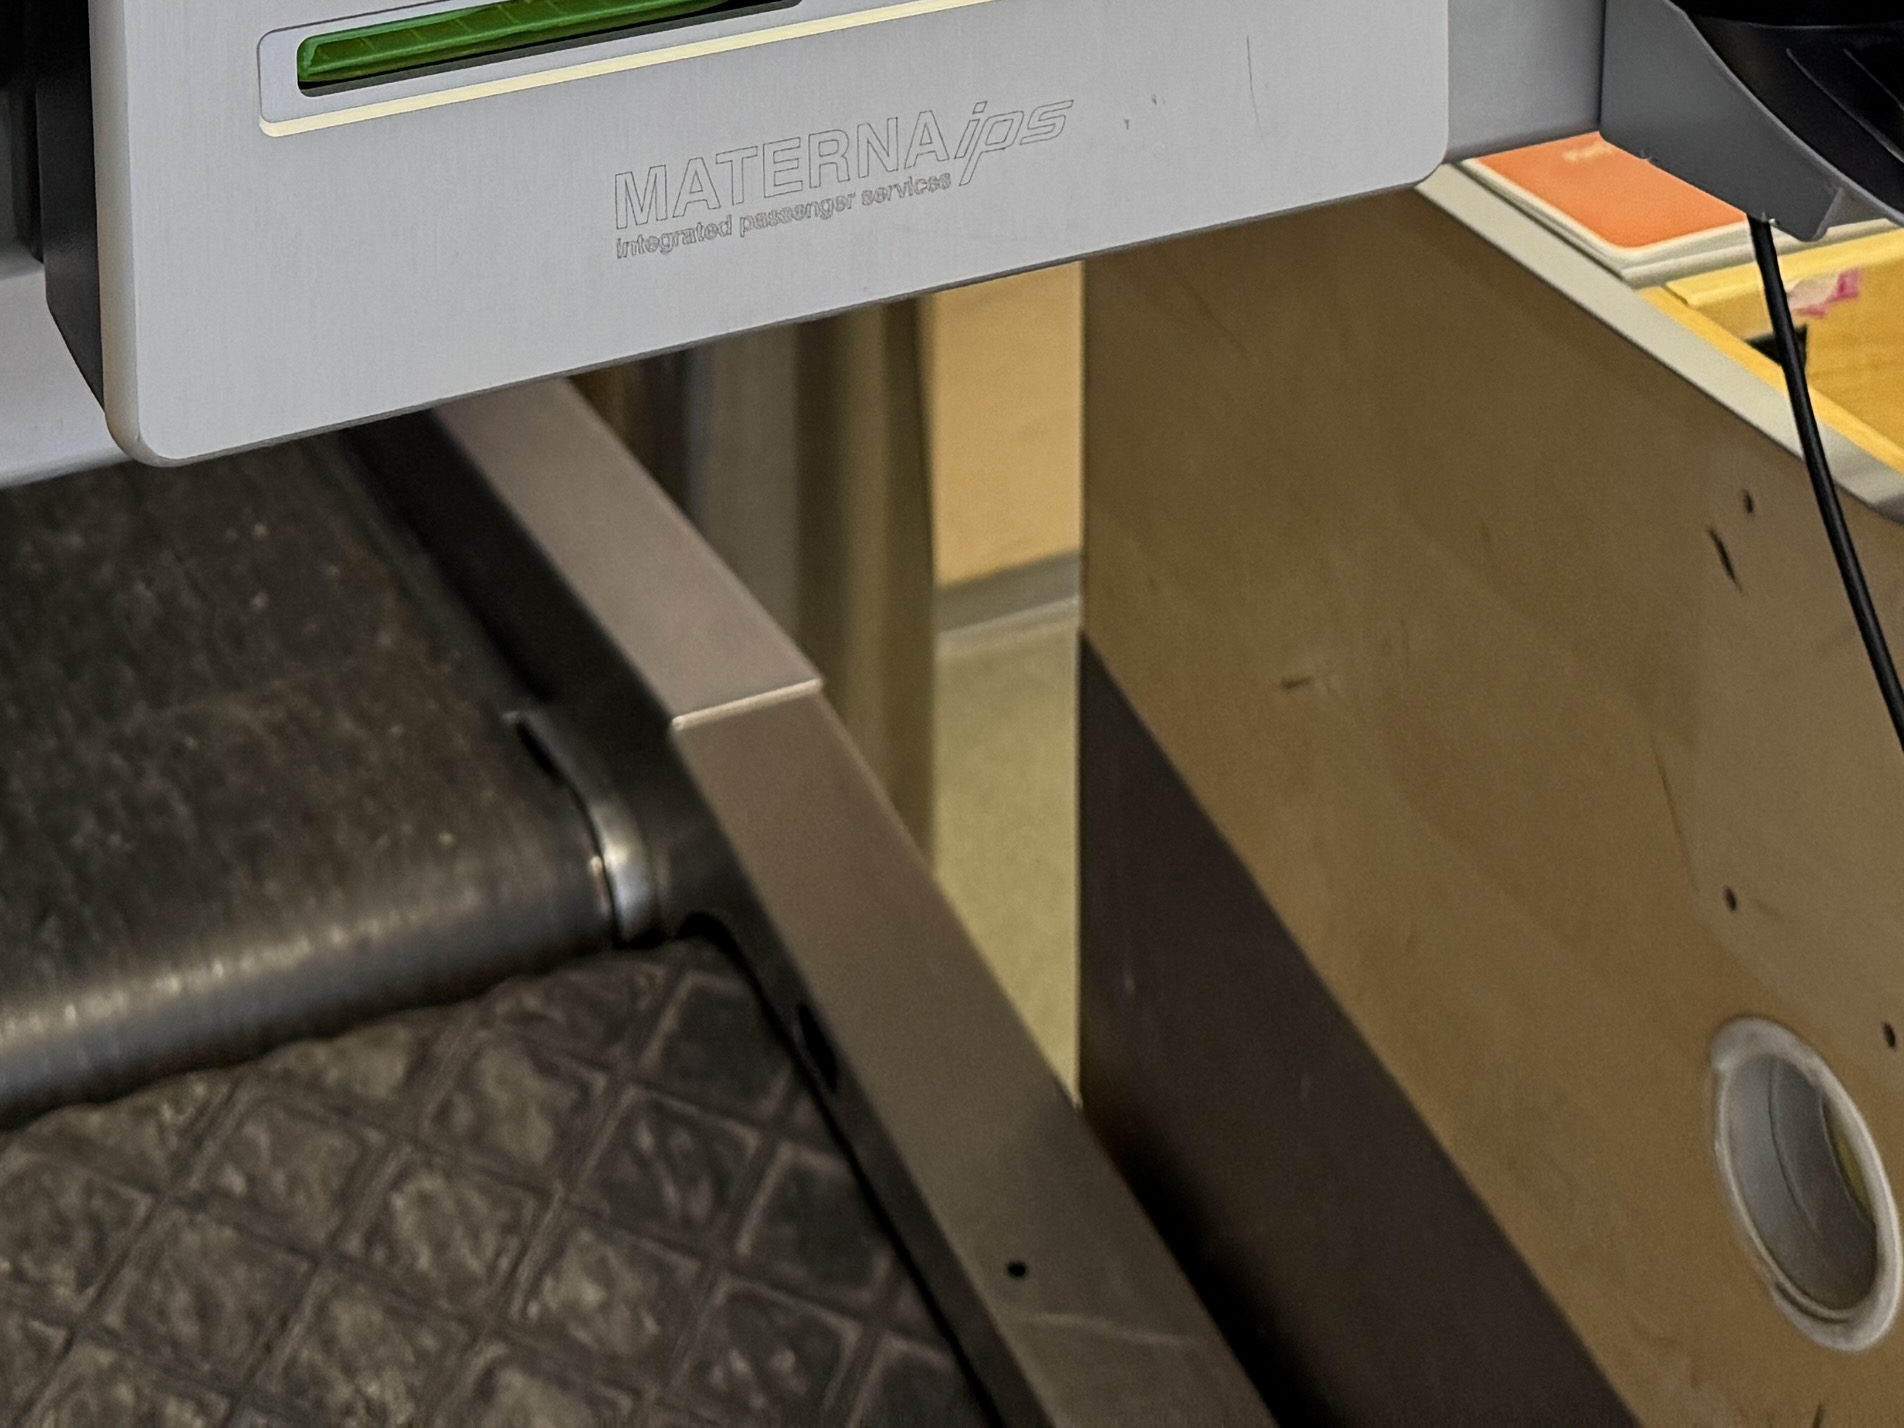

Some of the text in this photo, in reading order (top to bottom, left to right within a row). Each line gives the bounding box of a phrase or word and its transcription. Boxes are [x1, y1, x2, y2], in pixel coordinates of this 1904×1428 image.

[615, 110, 949, 229] MATERNA
[616, 172, 951, 259] integrated passenger services
